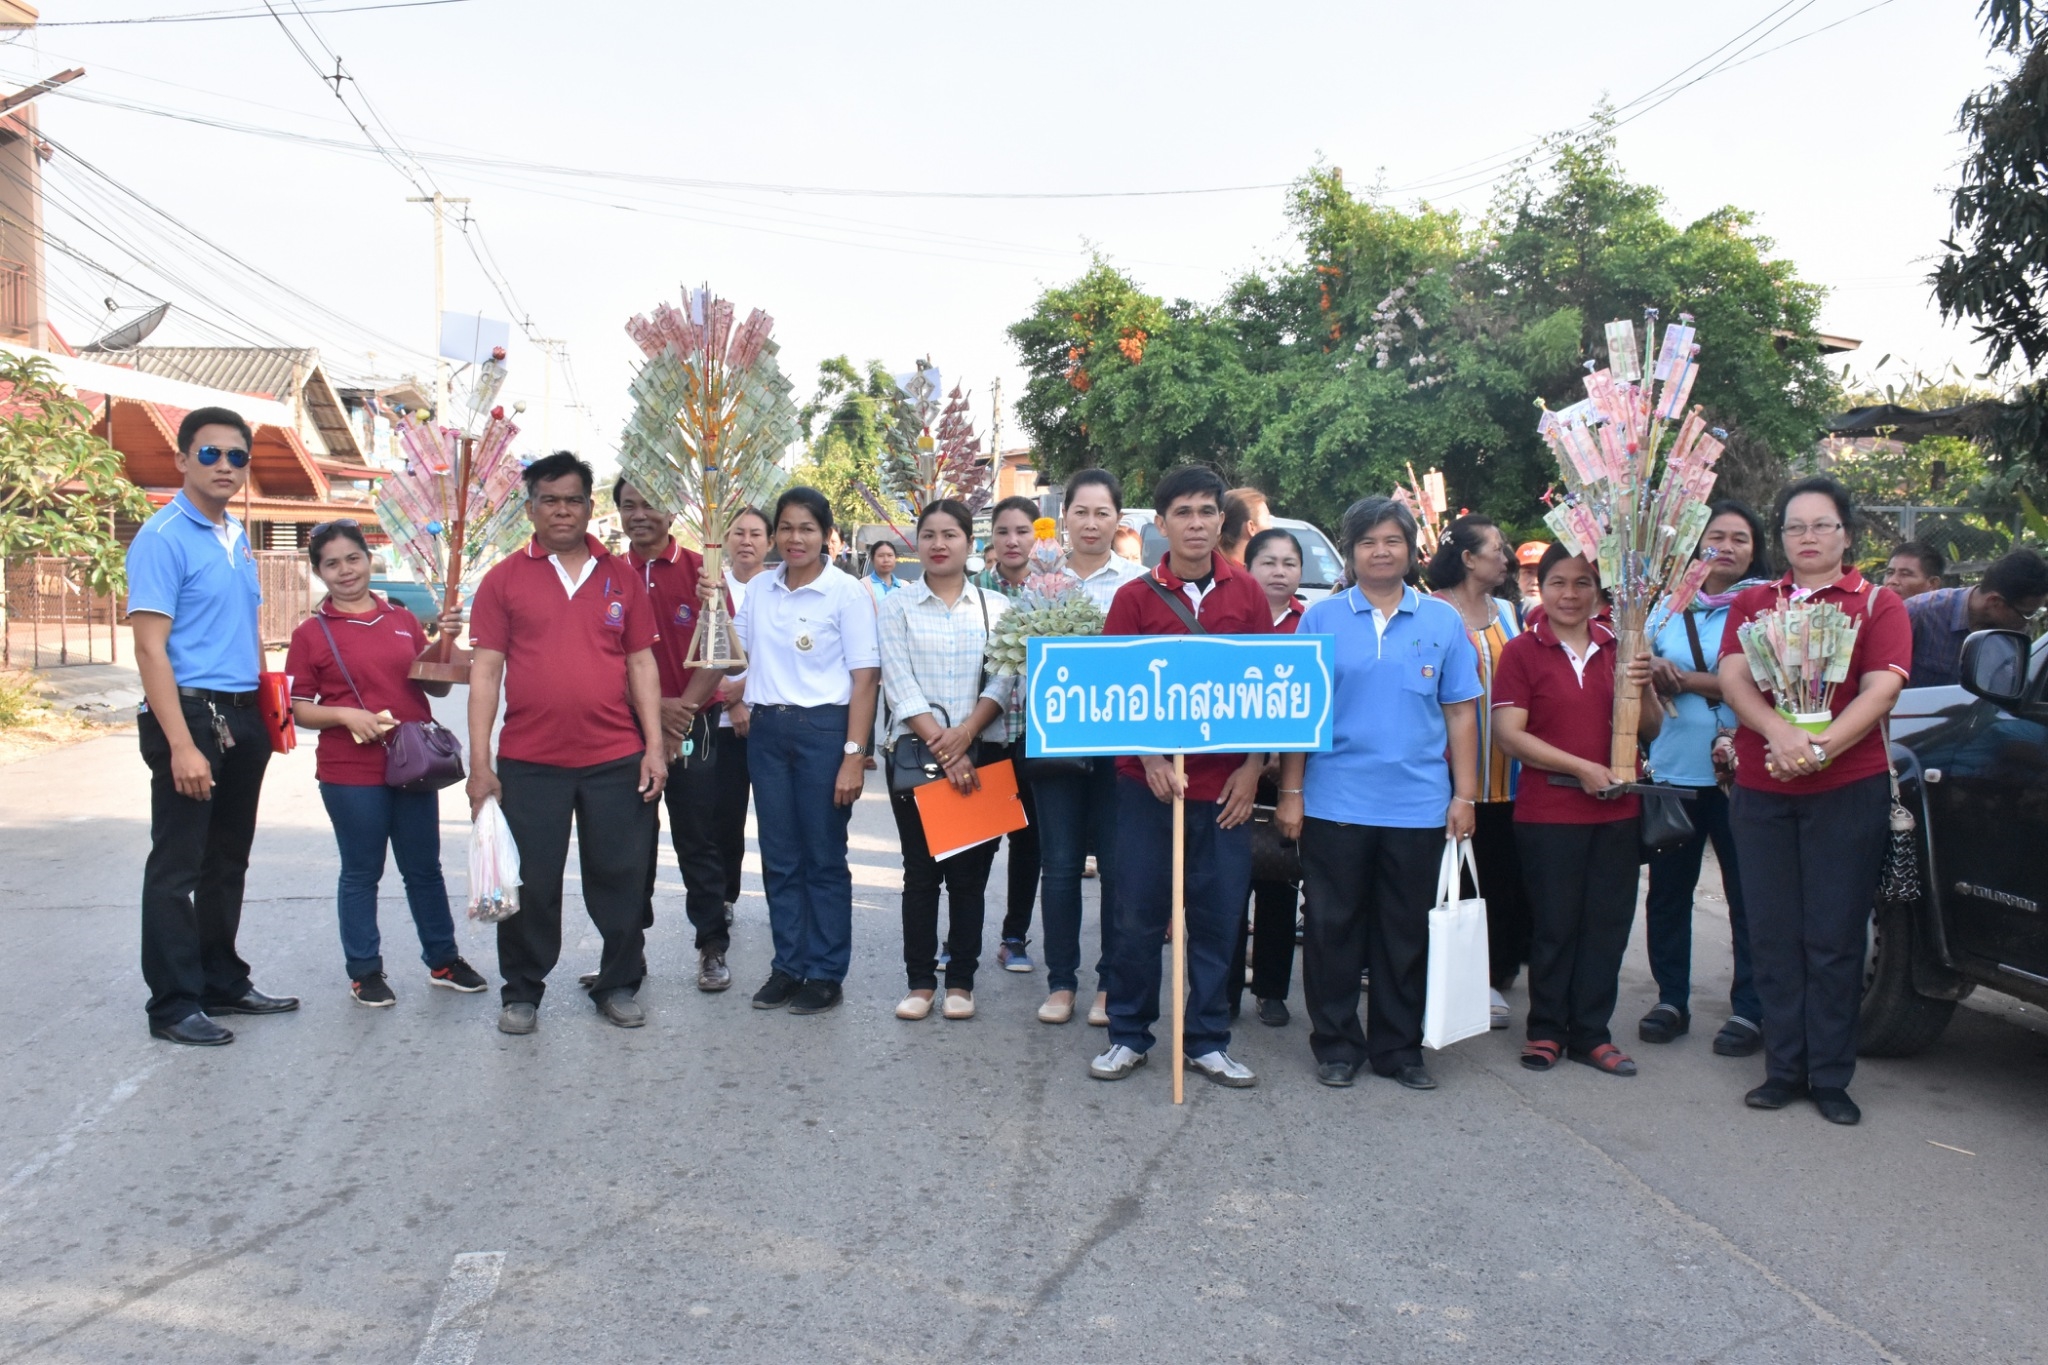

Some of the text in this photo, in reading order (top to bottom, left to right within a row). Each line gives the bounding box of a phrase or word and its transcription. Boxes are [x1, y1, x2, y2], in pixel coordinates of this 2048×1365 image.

[1045, 658, 1311, 741] อำเภอโกสุมพิสัย
[1973, 885, 2037, 912] COLORADO
